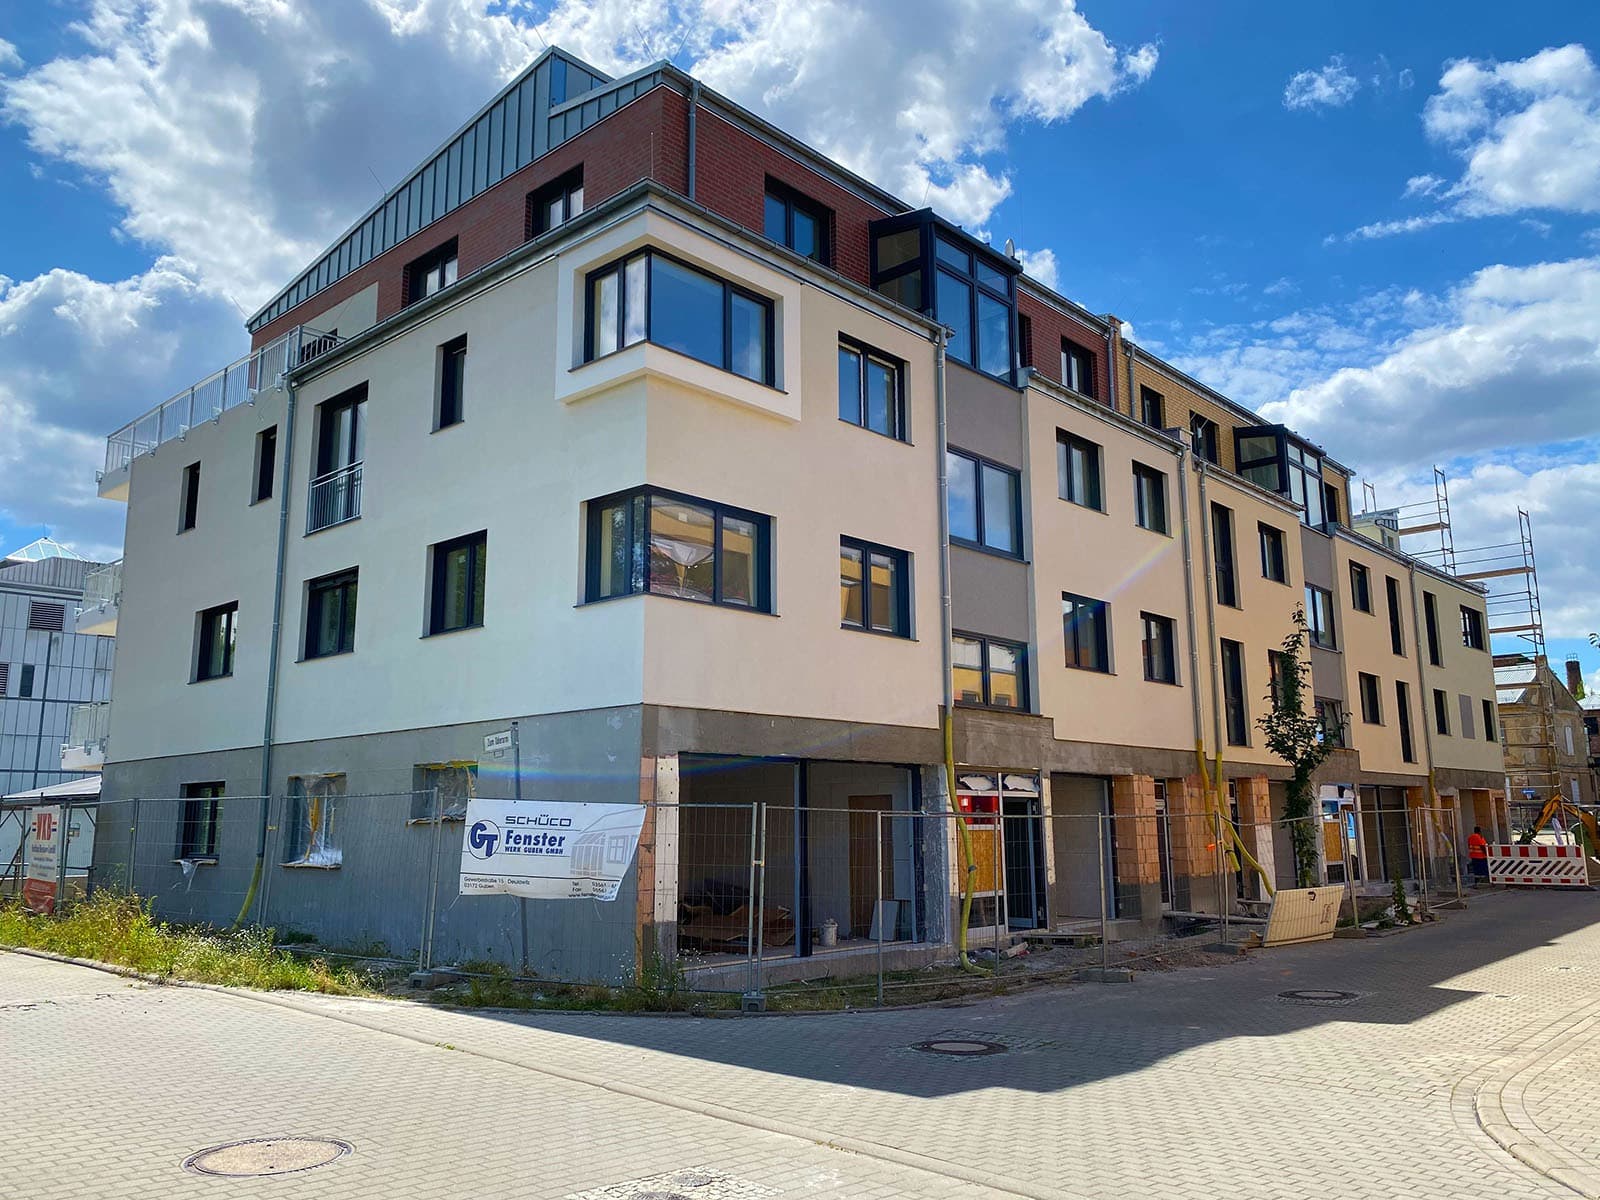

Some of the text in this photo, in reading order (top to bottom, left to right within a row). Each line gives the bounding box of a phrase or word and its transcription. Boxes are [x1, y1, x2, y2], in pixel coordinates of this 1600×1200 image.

[505, 814, 572, 827] SCHÜCO
[470, 822, 498, 857] GT
[505, 829, 565, 847] Fenster
[523, 846, 543, 854] GUBEN
